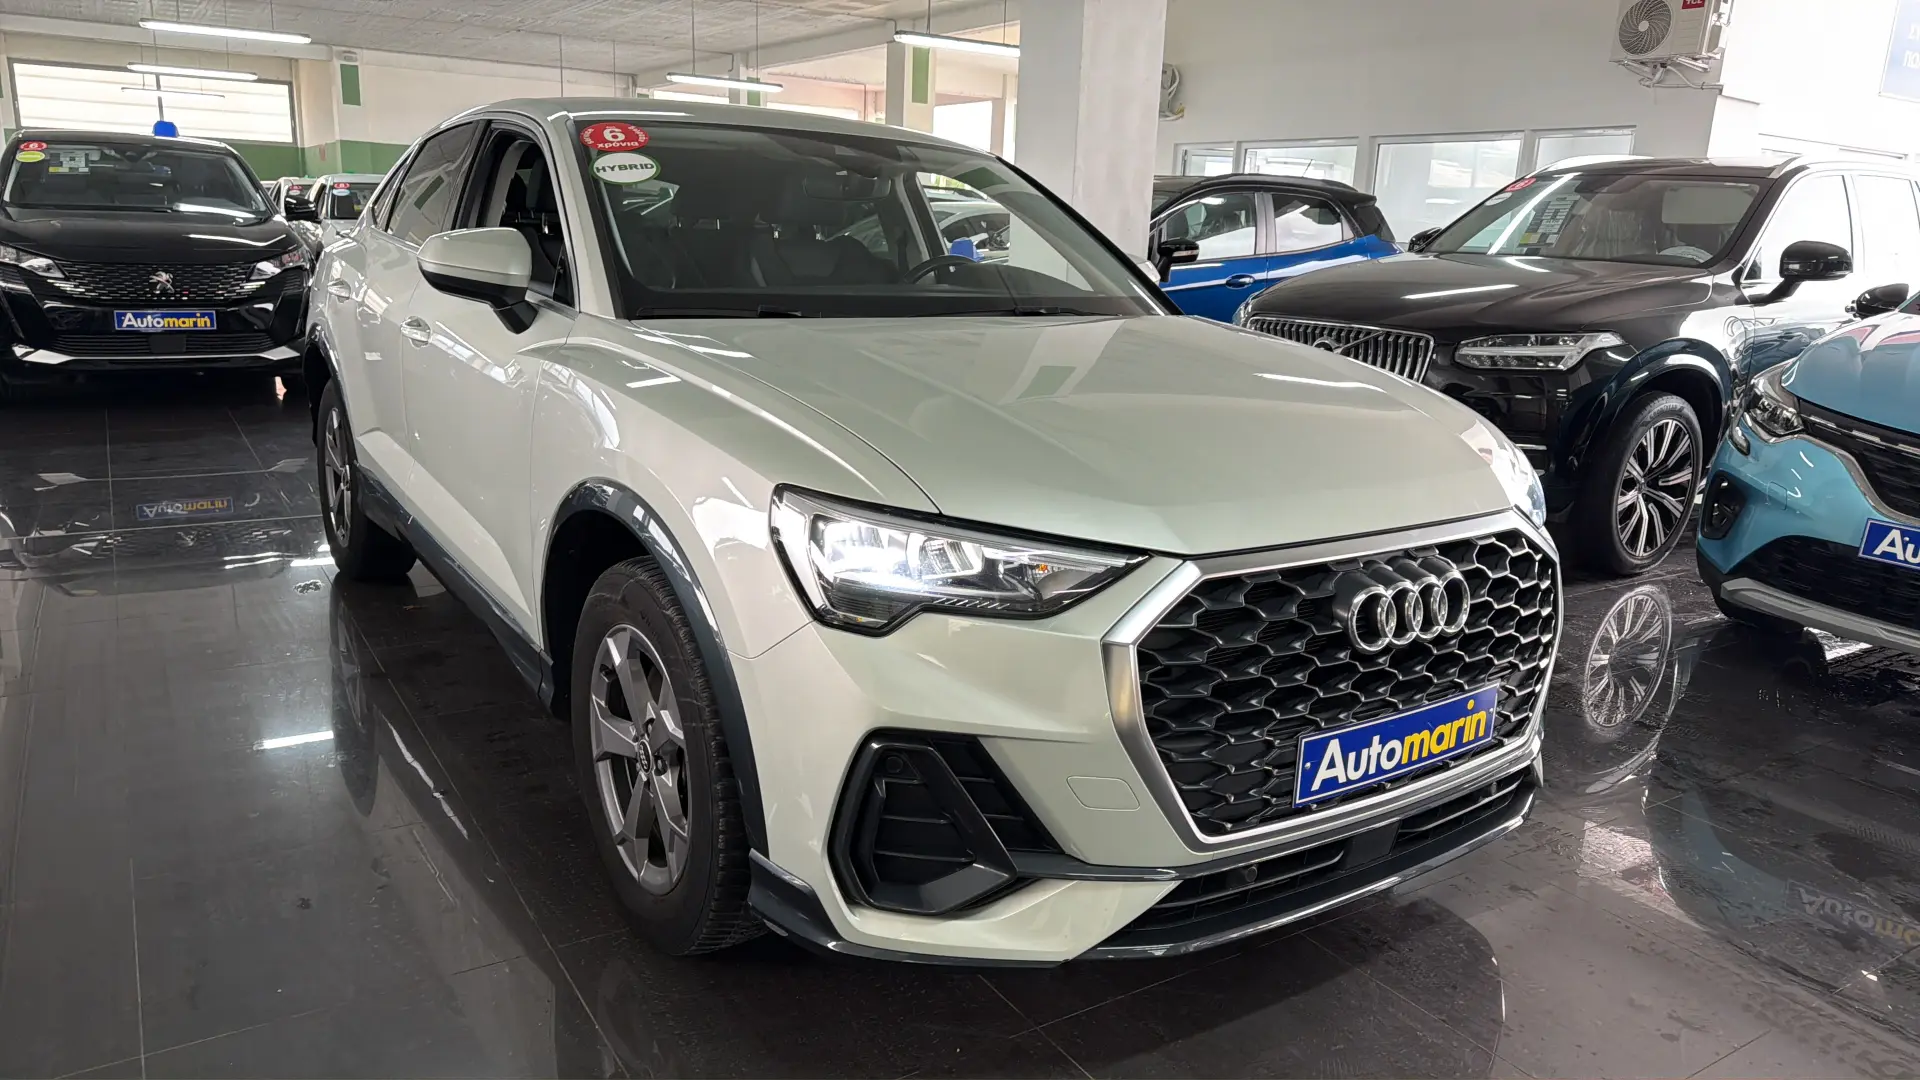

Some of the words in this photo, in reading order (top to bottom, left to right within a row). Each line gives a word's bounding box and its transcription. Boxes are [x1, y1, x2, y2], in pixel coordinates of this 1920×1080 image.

[603, 128, 625, 142] 6
[596, 141, 639, 150] χρόνια
[595, 163, 655, 174] HYBRID
[123, 312, 211, 329] Automarin
[1311, 699, 1487, 792] Automarin
